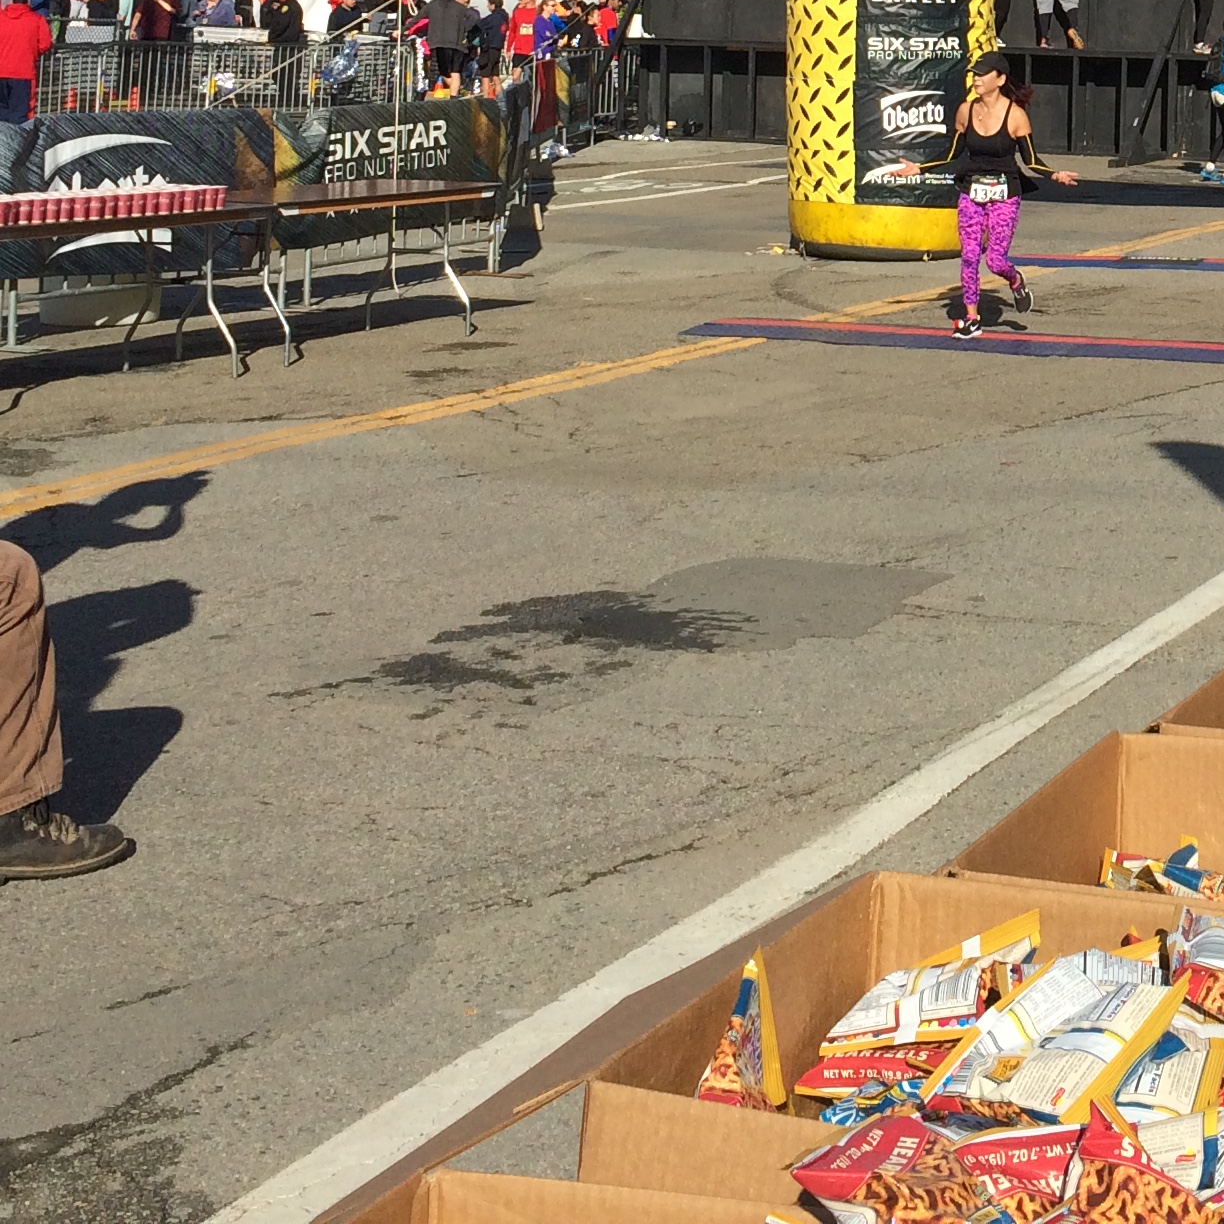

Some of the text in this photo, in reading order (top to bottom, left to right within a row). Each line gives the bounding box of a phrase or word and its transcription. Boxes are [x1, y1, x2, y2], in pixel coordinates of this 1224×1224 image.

[867, 37, 960, 51] SIX STAR
[868, 50, 961, 60] PRO NUTRITION
[883, 101, 945, 132] Oberto
[326, 119, 448, 163] SIX STAR
[364, 148, 448, 178] NUTRITION
[871, 174, 921, 184] NASM
[973, 187, 1005, 200] 1324
[823, 1069, 839, 1079] NET
[841, 1069, 857, 1079] WT.
[867, 1128, 884, 1146] NET
[1008, 1149, 1028, 1163] OZ.
[1042, 1144, 1064, 1157] WT.
